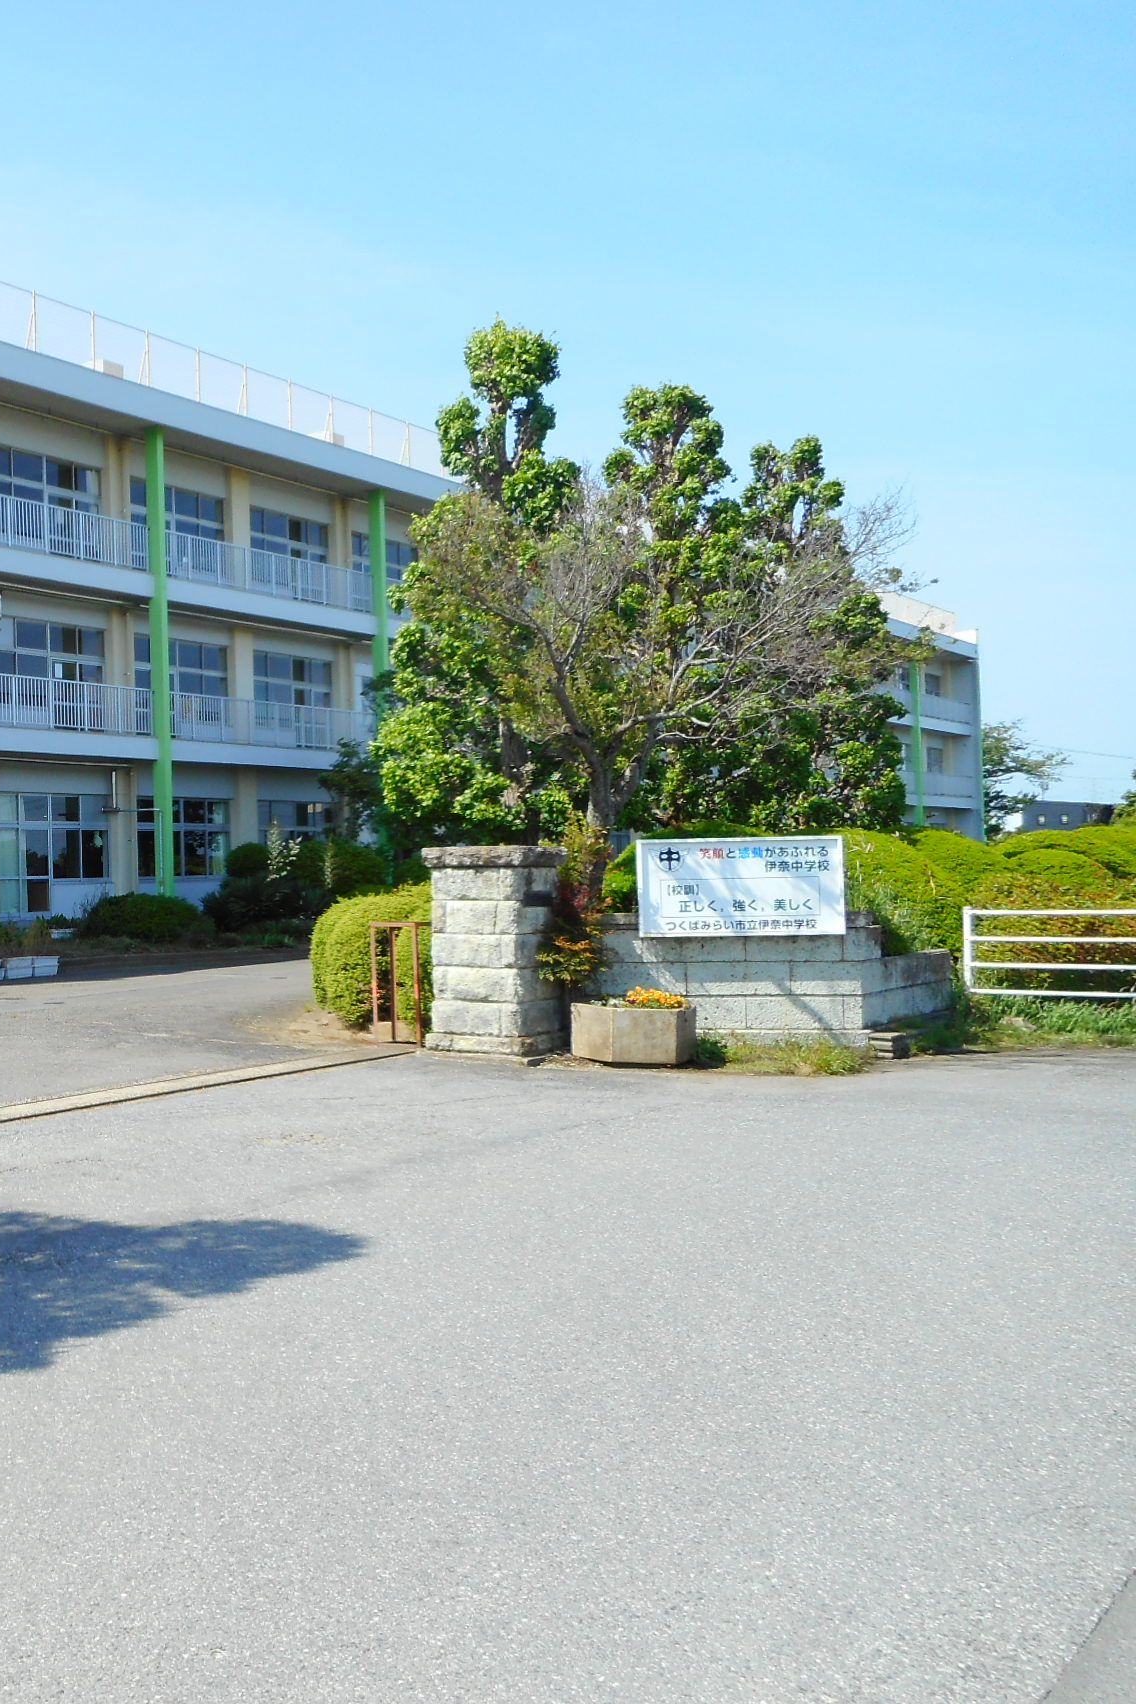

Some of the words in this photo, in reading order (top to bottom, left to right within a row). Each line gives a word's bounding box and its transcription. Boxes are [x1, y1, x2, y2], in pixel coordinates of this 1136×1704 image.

[699, 846, 829, 859] 笑顔と感動があふれる
[765, 860, 830, 872] 伊奈中学校
[665, 919, 817, 931] つくばみらい市立伊奈中学校
